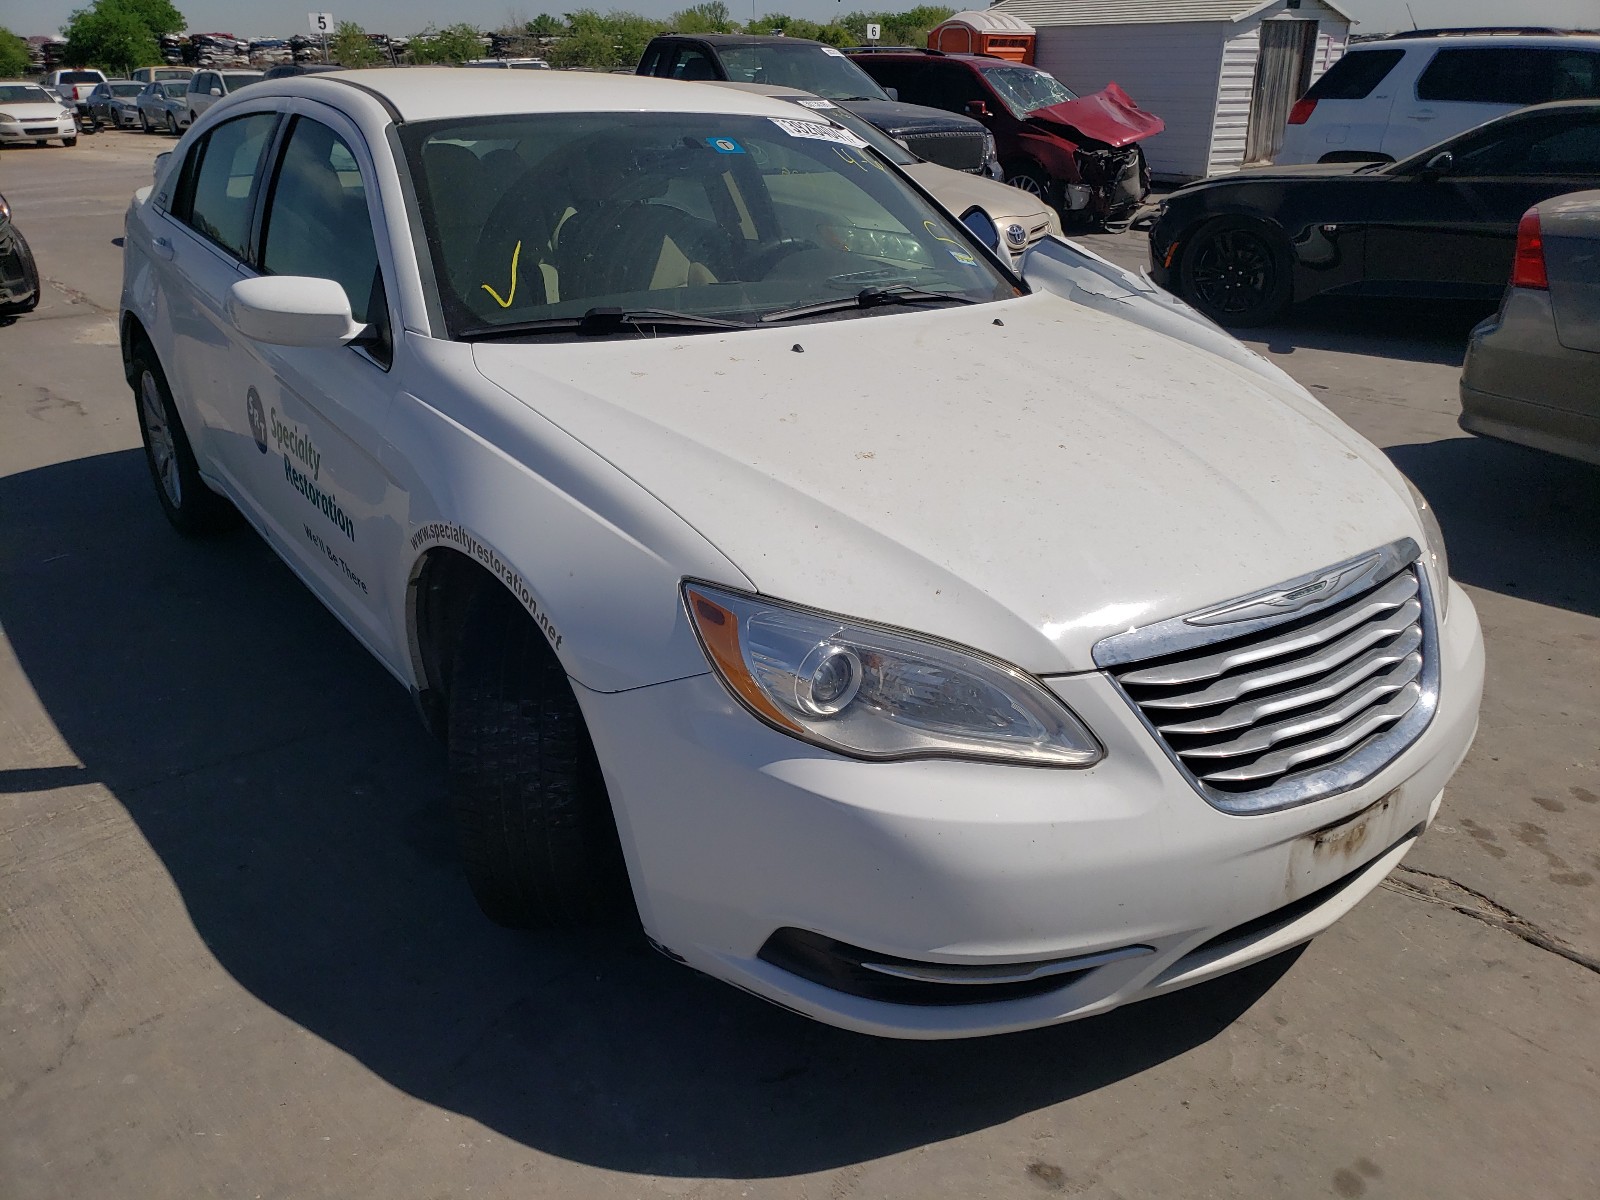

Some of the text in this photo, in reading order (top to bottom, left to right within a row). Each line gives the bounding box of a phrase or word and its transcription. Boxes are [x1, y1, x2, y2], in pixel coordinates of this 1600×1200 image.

[317, 16, 326, 30] 5
[871, 26, 877, 37] 6
[270, 406, 321, 482] Specialty
[283, 452, 355, 543] Restoration
[303, 522, 369, 595] We'll Be There
[410, 521, 563, 651] www.specialtyrestoration.net
